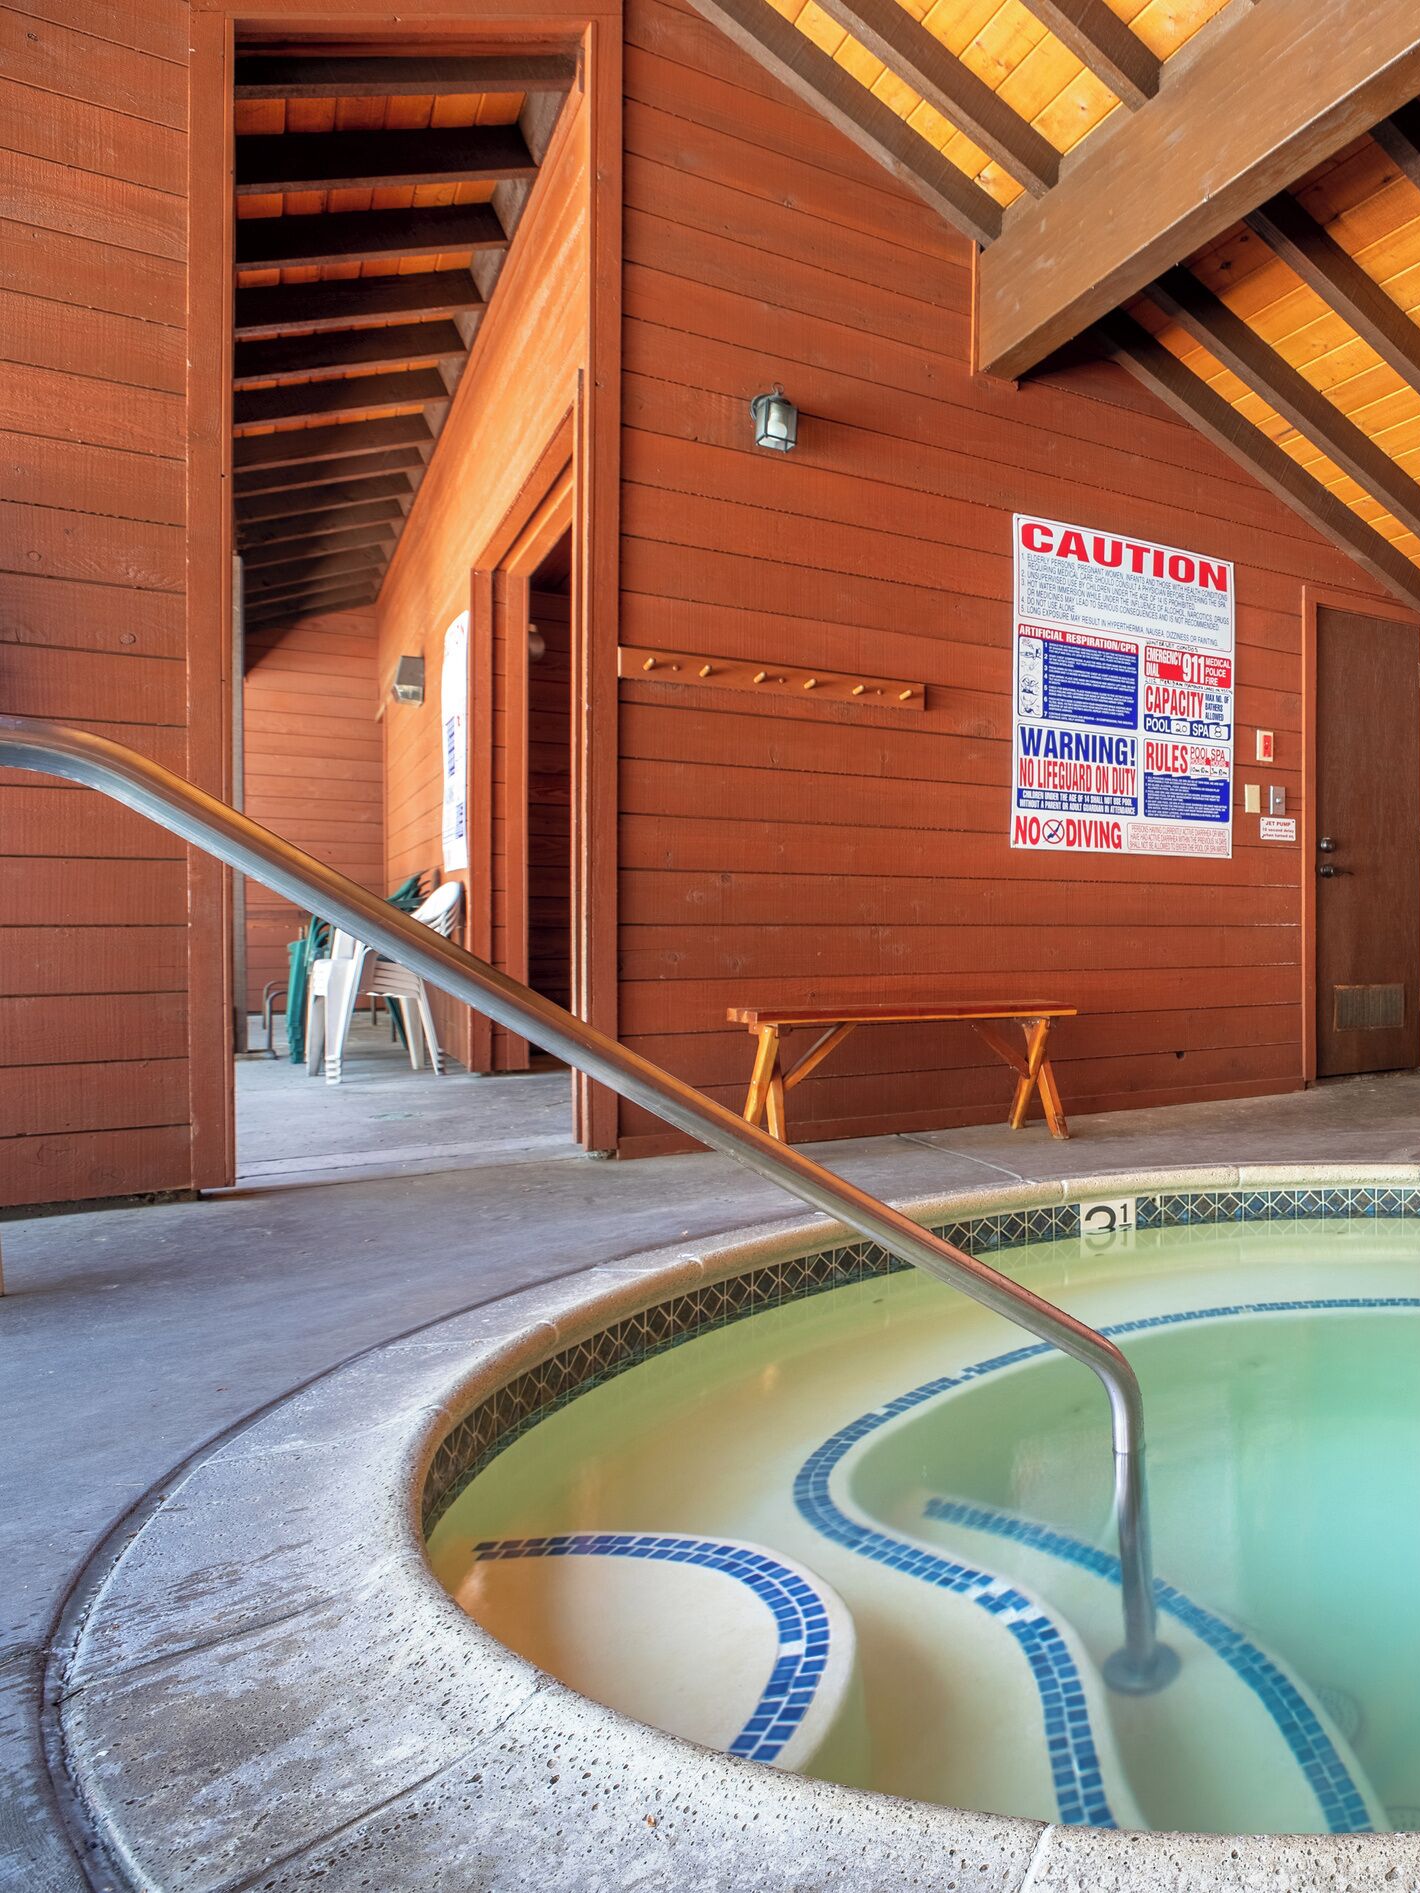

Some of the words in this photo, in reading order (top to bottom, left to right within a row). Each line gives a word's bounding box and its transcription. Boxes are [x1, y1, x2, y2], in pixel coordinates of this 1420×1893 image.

[1021, 520, 1227, 591] CAUTION
[1027, 553, 1049, 565] ELDERLY
[1077, 563, 1103, 576] PREGNANT
[1126, 573, 1144, 584] INFANTS
[1145, 577, 1154, 586] AND
[1156, 579, 1170, 589] THOSE
[1172, 582, 1183, 592] WITH
[1184, 585, 1200, 595] HEALTH
[1201, 589, 1227, 600] CONDITIONS
[1028, 561, 1055, 574] REQUIRING
[1057, 567, 1078, 579] MEDICAL
[1080, 572, 1093, 582] CARE
[1094, 574, 1114, 586] SHOULD
[1116, 579, 1136, 590] CONSULT
[1142, 584, 1165, 596] PHYSICIAN
[1167, 589, 1184, 599] BEFORE
[1185, 593, 1207, 604] ENTERING
[1027, 570, 1066, 585] UNSUPERVISED
[1068, 578, 1077, 587] USE
[1079, 580, 1084, 588] BY
[1086, 581, 1110, 593] CHILDREN
[1112, 586, 1128, 597] UNDER
[1129, 590, 1137, 599] THE
[1139, 592, 1148, 601] AGE
[1149, 594, 1155, 602] OF
[1162, 596, 1167, 604] IS
[1027, 579, 1037, 588] HOT
[1039, 581, 1055, 592] WATER
[1057, 584, 1085, 597] IMMERSION
[1086, 590, 1100, 600] WHILE
[1102, 593, 1119, 604] UNDER
[1120, 596, 1128, 605] THE
[1130, 598, 1155, 610] INFLUENCE
[1157, 604, 1163, 612] OF
[1214, 614, 1228, 624] DRUGS
[1027, 596, 1034, 605] DO
[1036, 598, 1045, 607] NOT
[1047, 600, 1057, 609] USE
[1027, 587, 1034, 596] OR
[1036, 589, 1063, 602] MEDICINES
[1064, 594, 1074, 604] MAY
[1076, 596, 1088, 606] LEAD
[1089, 599, 1096, 608] TO
[1097, 600, 1118, 612] SERIOUS
[1119, 605, 1157, 619] CONSEQUENCES
[1158, 612, 1168, 621] AND
[1174, 615, 1183, 624] NOT
[1026, 605, 1040, 615] LONG
[1042, 608, 1069, 620] EXPOSURE
[1070, 613, 1079, 622] MAY
[1081, 615, 1099, 626] RESULT
[1101, 618, 1106, 627] IN
[1166, 630, 1188, 641] DIZZINESS
[1190, 634, 1196, 642] OR
[1019, 625, 1063, 640] ARTIFICIAL
[1065, 633, 1135, 652] RESPIRATION/CPR
[1146, 646, 1182, 666] EMERGENCY
[1205, 657, 1230, 668] MEDICAL
[1146, 661, 1159, 677] DIAL
[1182, 652, 1204, 684] 911
[1205, 667, 1226, 677] POLICE
[1205, 676, 1217, 685] FIRE
[1145, 684, 1203, 719] CAPACITY
[1205, 693, 1214, 701] MAX
[1205, 702, 1223, 712] BATHERS
[1146, 717, 1170, 732] POOL
[1205, 712, 1223, 721] ALLOWED
[1175, 722, 1186, 733] 20
[1192, 723, 1208, 736] SPA
[1214, 725, 1222, 737] 8
[1019, 726, 1135, 766] WARNING!
[1190, 746, 1208, 759] POOL
[1211, 748, 1225, 761] SPA
[1146, 741, 1187, 773] RULES
[1019, 757, 1033, 787] NO
[1037, 759, 1091, 792] LIFEGUARD
[1095, 765, 1108, 793] ON
[1112, 766, 1135, 795] DUTY
[1019, 798, 1039, 808] WITHOUT
[1040, 800, 1044, 808] A
[1045, 800, 1060, 809] PARENT
[1062, 802, 1068, 810] OR
[1069, 802, 1081, 811] ADULT
[1083, 803, 1103, 812] GUARDIAN
[1110, 805, 1135, 814] ATTENDANCE
[1022, 790, 1043, 799] CHILDREN
[1044, 791, 1058, 800] UNDER
[1077, 794, 1083, 802] OF
[1090, 795, 1103, 803] SHALL
[1104, 796, 1112, 804] NOT
[1015, 815, 1040, 845] NO
[1066, 819, 1121, 849] DIVING
